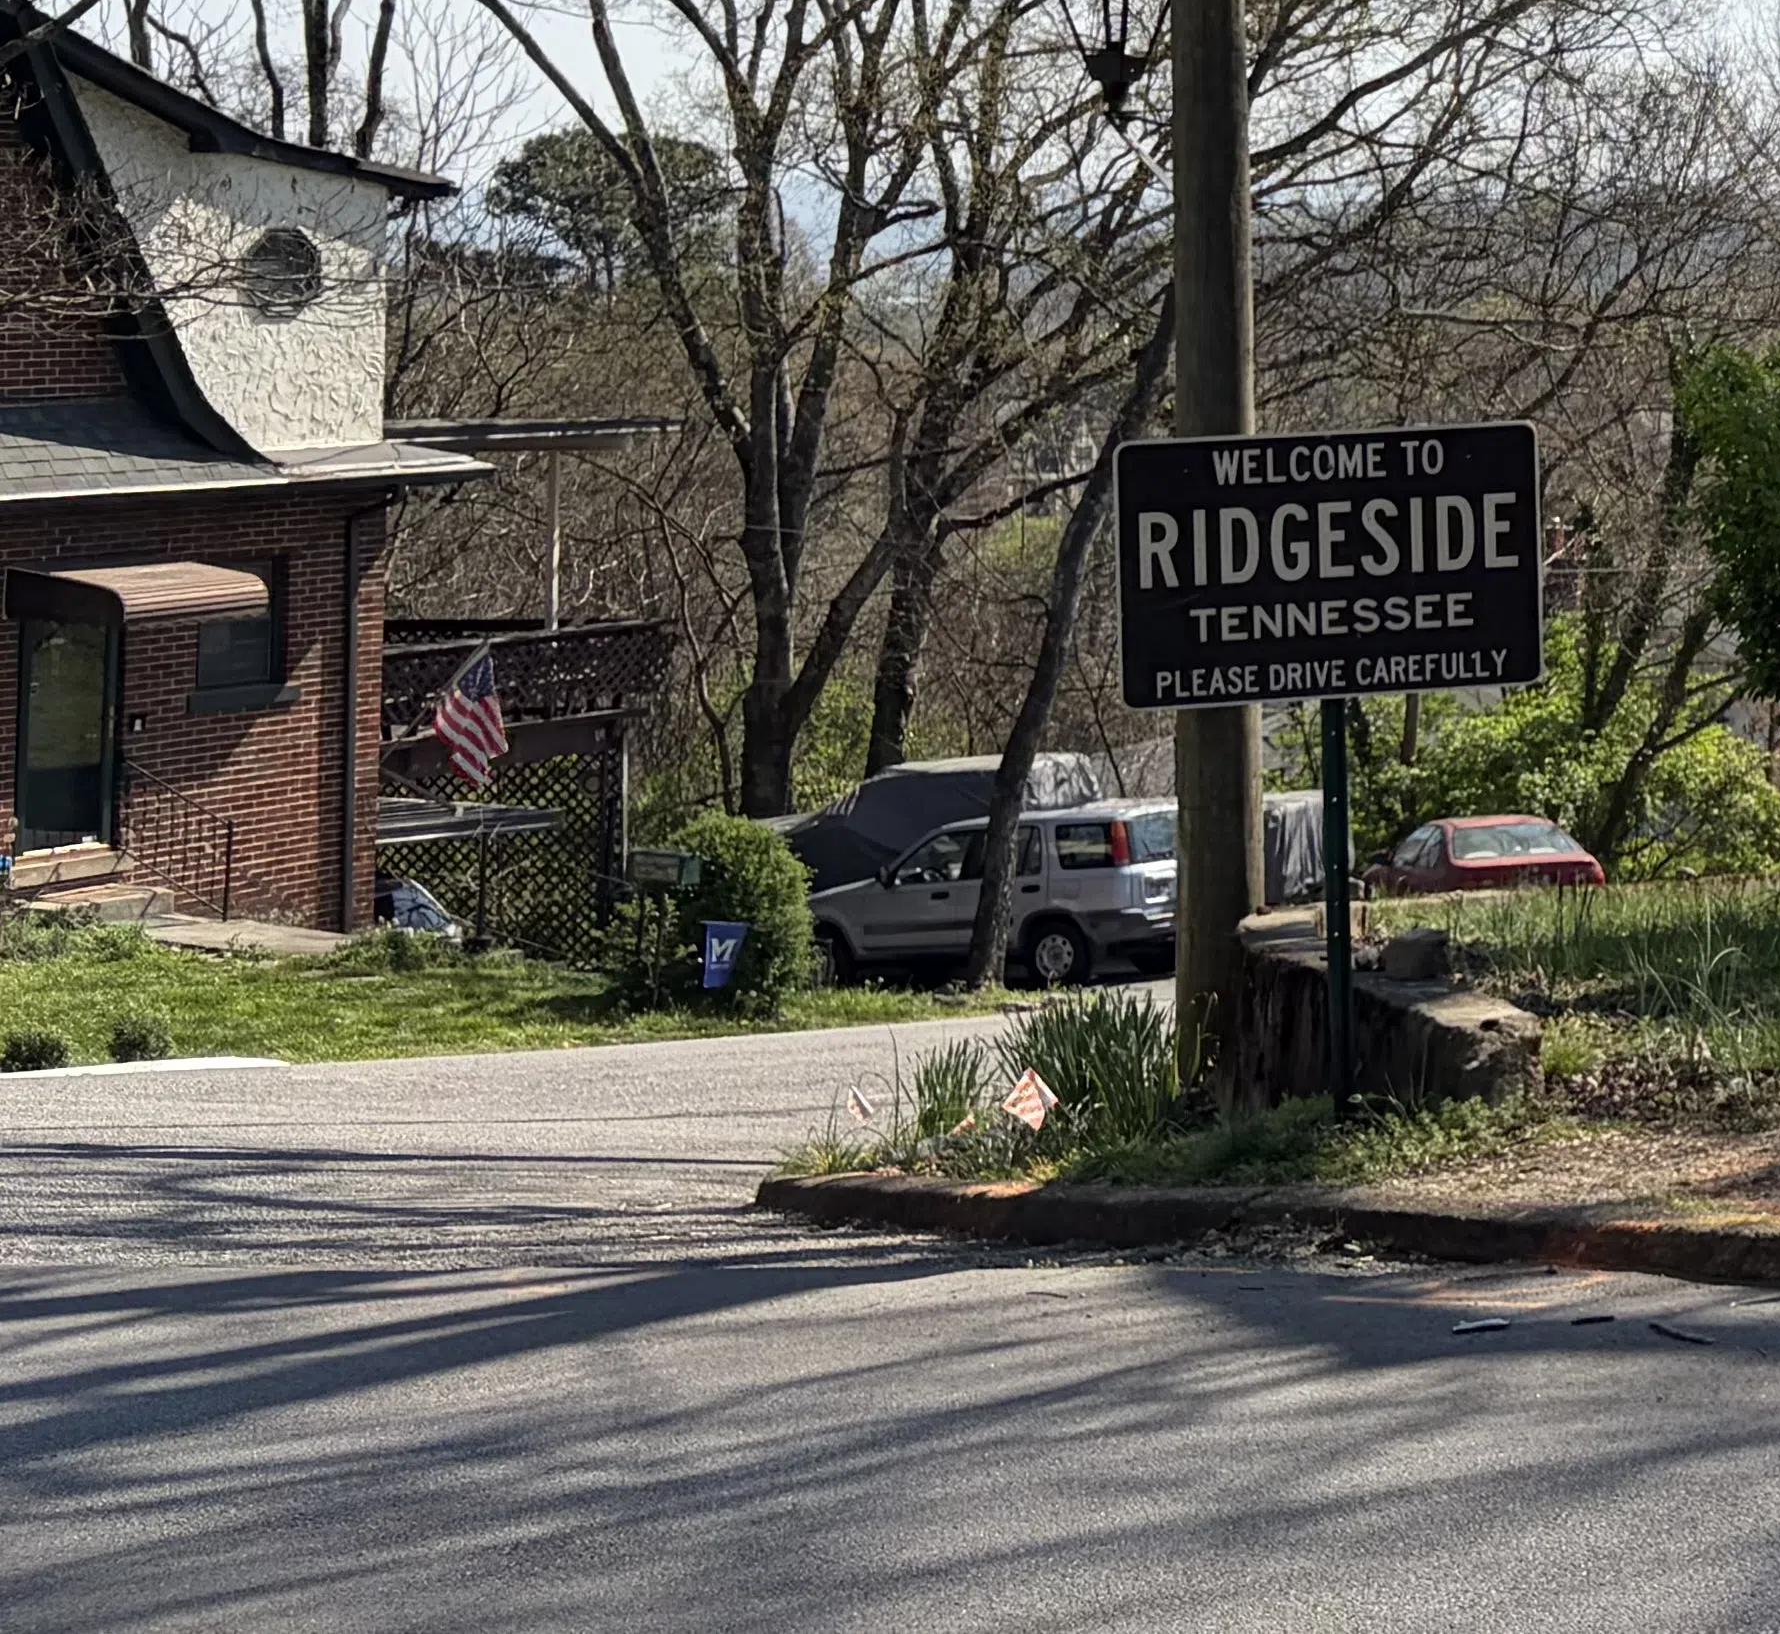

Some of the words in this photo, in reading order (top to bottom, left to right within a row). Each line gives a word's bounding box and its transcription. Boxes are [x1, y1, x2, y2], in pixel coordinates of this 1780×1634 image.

[1212, 442, 1387, 486] WELCOME
[1400, 439, 1444, 476] TO
[1138, 492, 1520, 590] RIDGESIDE
[1189, 592, 1475, 643] TENNESSEE
[1156, 665, 1261, 700] PLEASE
[1269, 658, 1347, 692] DRIVE
[1355, 648, 1508, 686] CAREFULLY
[711, 938, 737, 963] M
